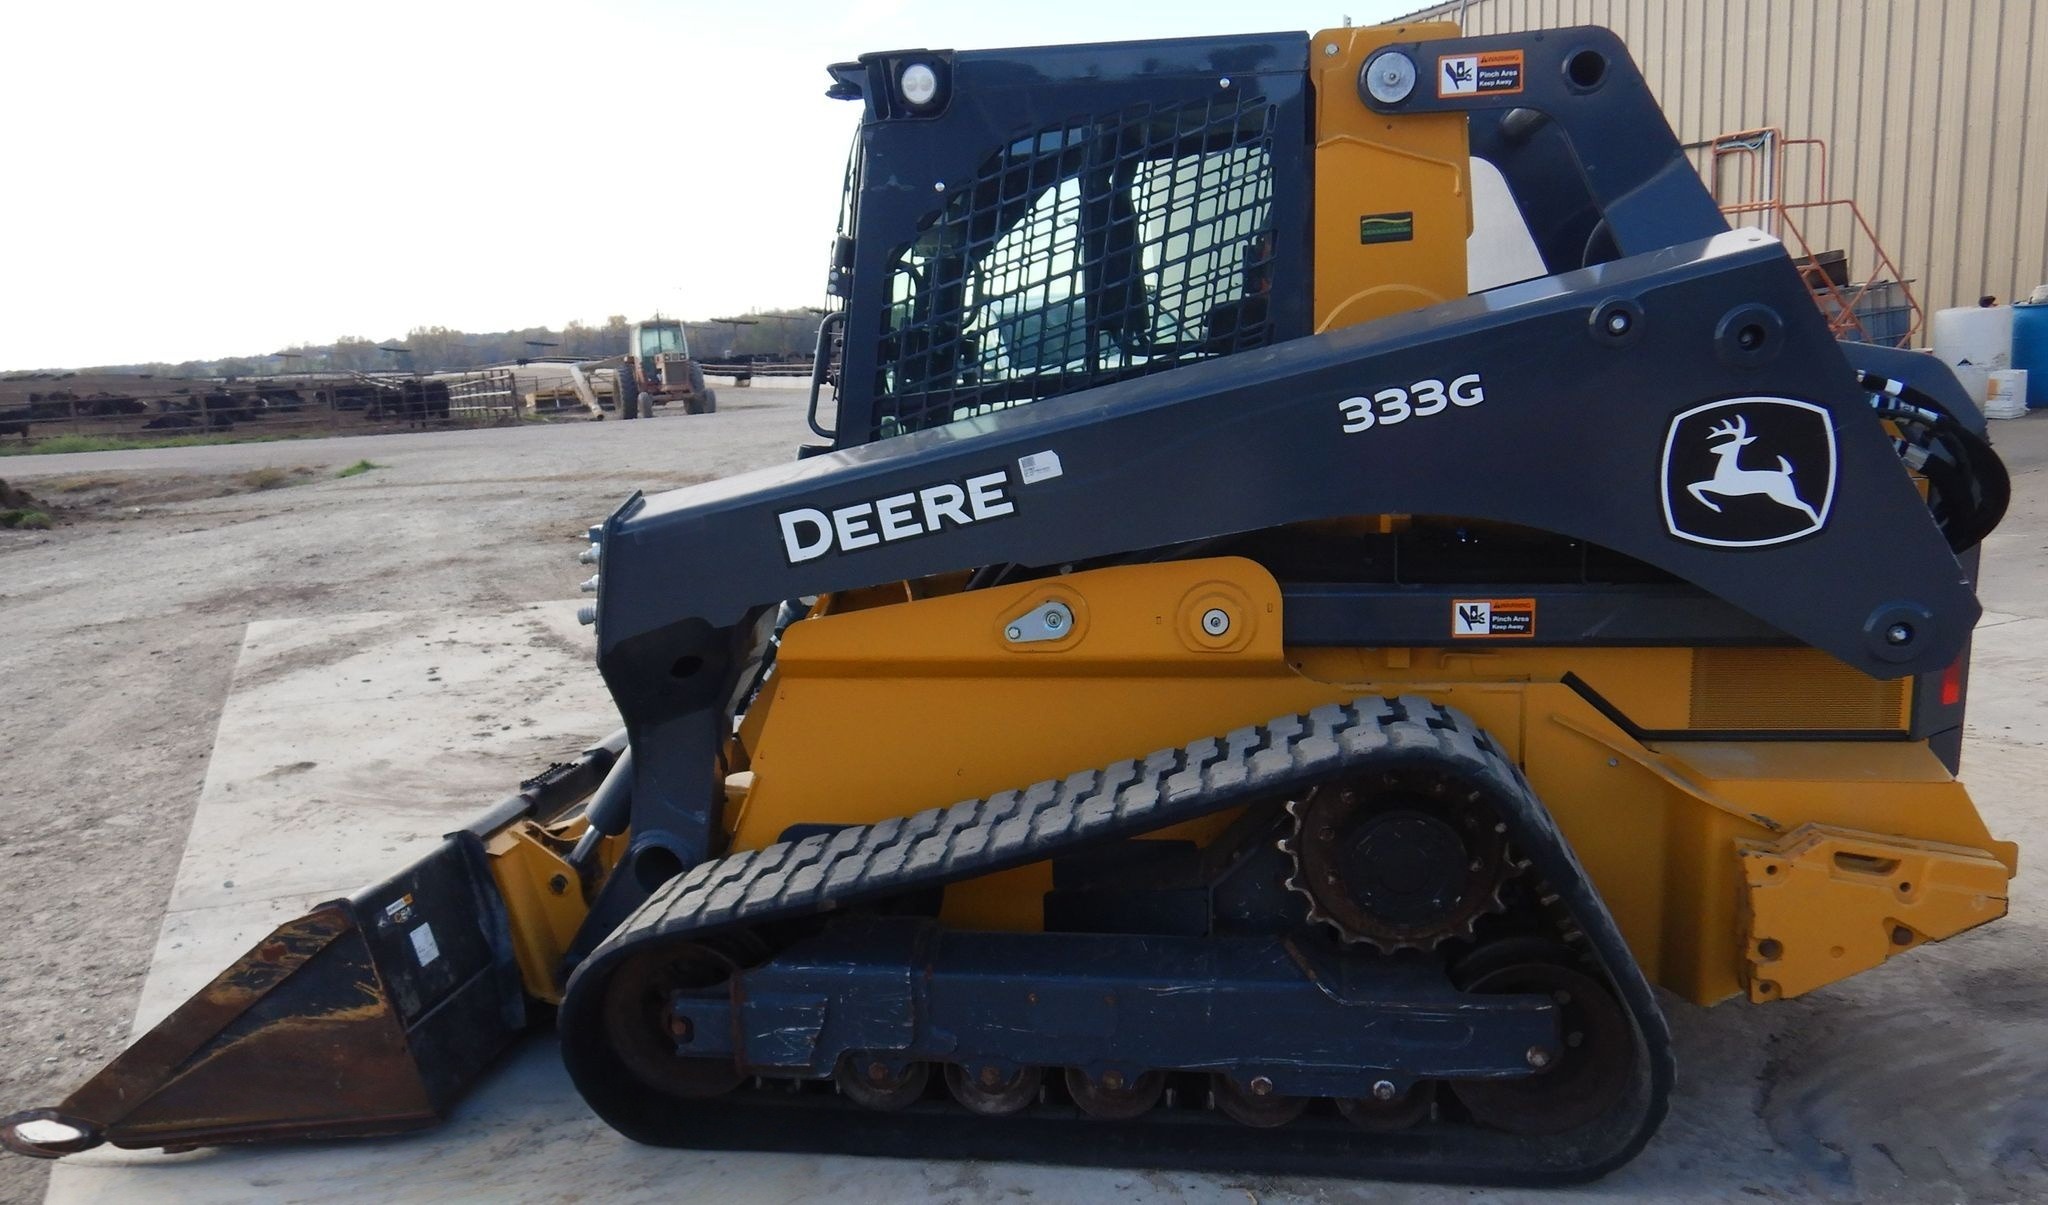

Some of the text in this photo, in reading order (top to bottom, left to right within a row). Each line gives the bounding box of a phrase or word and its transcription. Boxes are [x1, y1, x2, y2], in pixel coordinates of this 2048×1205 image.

[1479, 69, 1518, 79] Pinch Area
[1479, 79, 1513, 88] Keep Away
[1338, 373, 1485, 434] 333G
[778, 471, 1014, 563] DEERE
